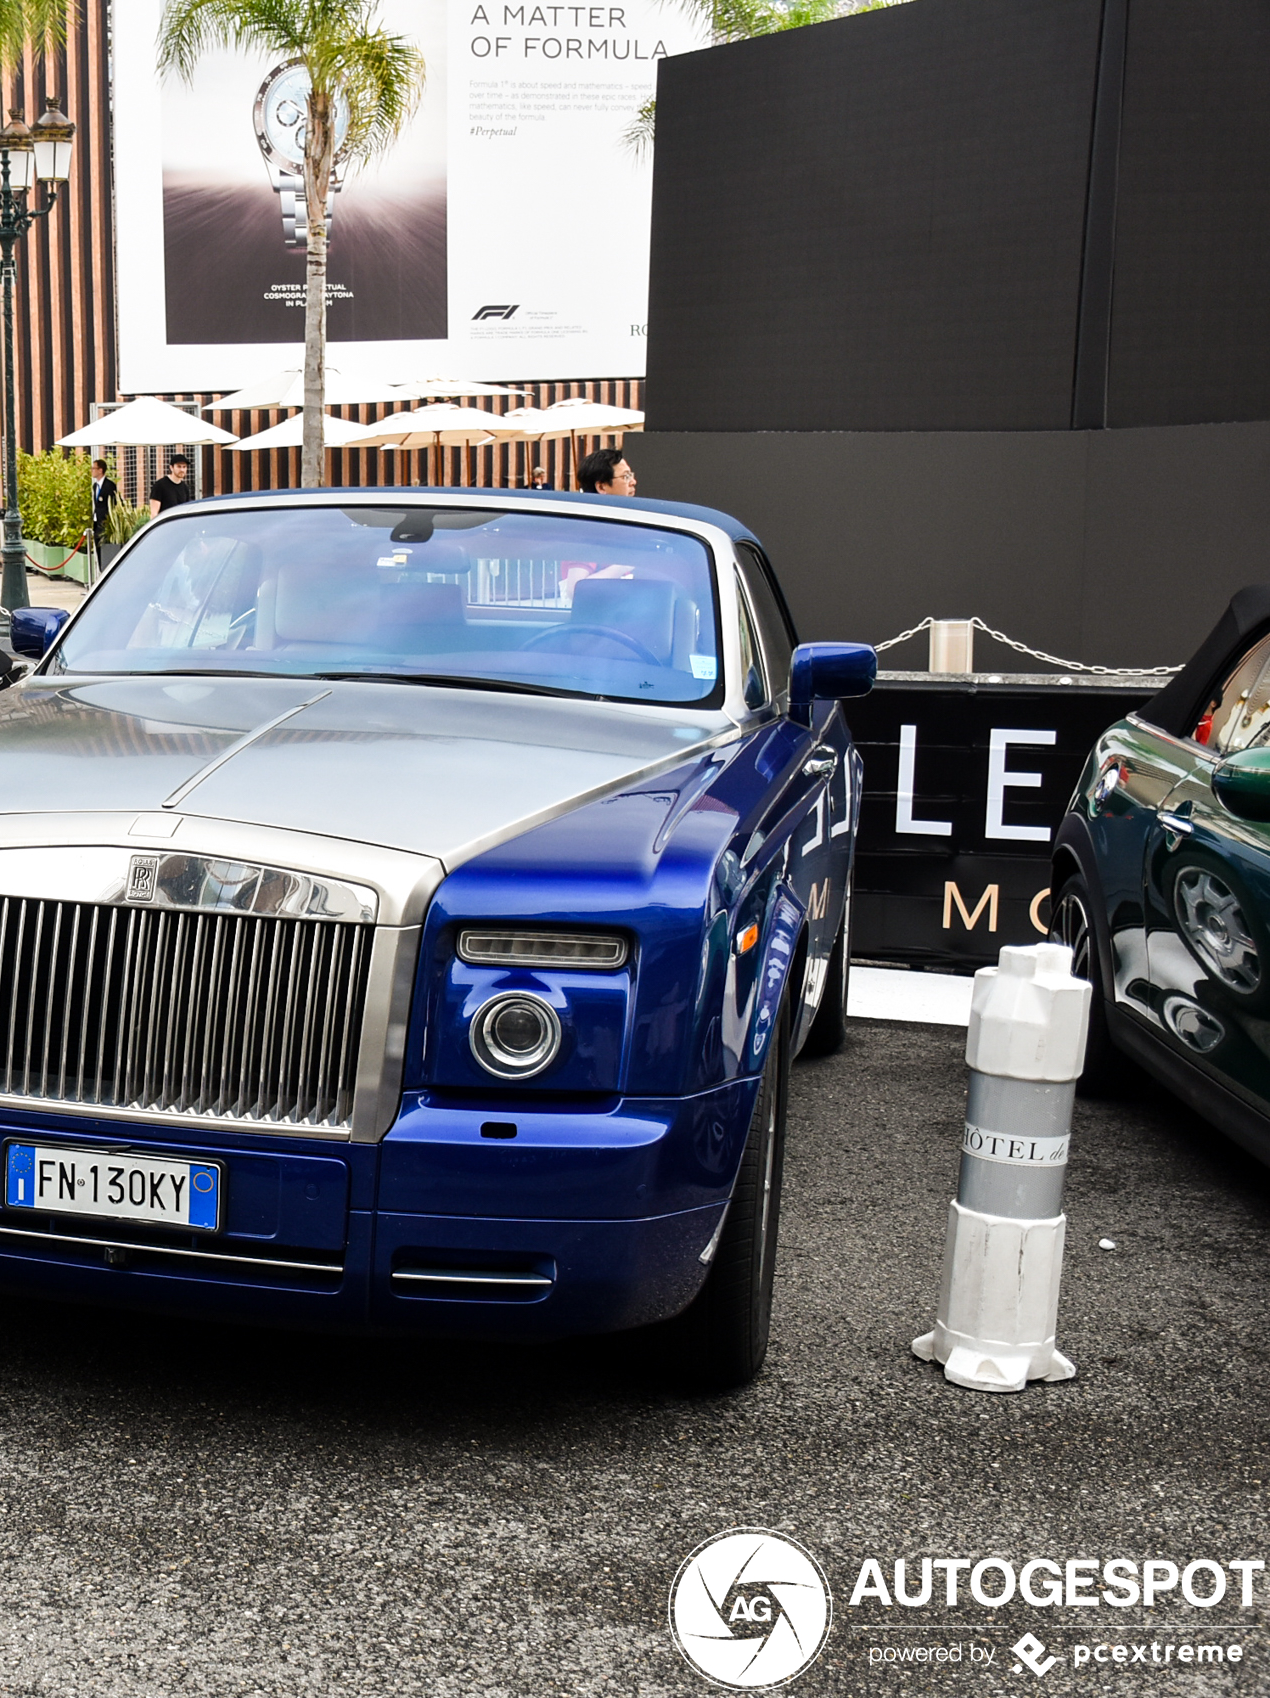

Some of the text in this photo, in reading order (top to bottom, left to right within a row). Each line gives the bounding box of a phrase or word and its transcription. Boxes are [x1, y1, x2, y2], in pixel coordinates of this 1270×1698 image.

[470, 4, 627, 28] A MATTER
[471, 36, 669, 60] OF FORMULA
[469, 79, 498, 88] Formula
[511, 81, 517, 89] is
[518, 81, 538, 89] about
[540, 81, 562, 91] speed
[563, 82, 577, 90] and
[578, 82, 623, 91] mathematics
[631, 82, 652, 92] speed
[469, 92, 485, 100] over
[487, 91, 503, 100] time
[511, 92, 519, 100] as
[520, 91, 570, 100] demonstrated
[572, 92, 578, 101] in
[580, 92, 600, 101] these
[601, 93, 616, 103] epic
[519, 102, 532, 110] like
[594, 103, 611, 113] fully
[610, 105, 635, 114] convey
[469, 112, 494, 122] beauty
[495, 112, 503, 121] of
[504, 113, 517, 121] the
[470, 126, 517, 140] #Perpetual
[270, 284, 301, 292] OYSTER
[263, 291, 307, 300] COSMOGRA
[963, 1127, 1064, 1161] HÔTEL de
[89, 1165, 186, 1213] 130KY
